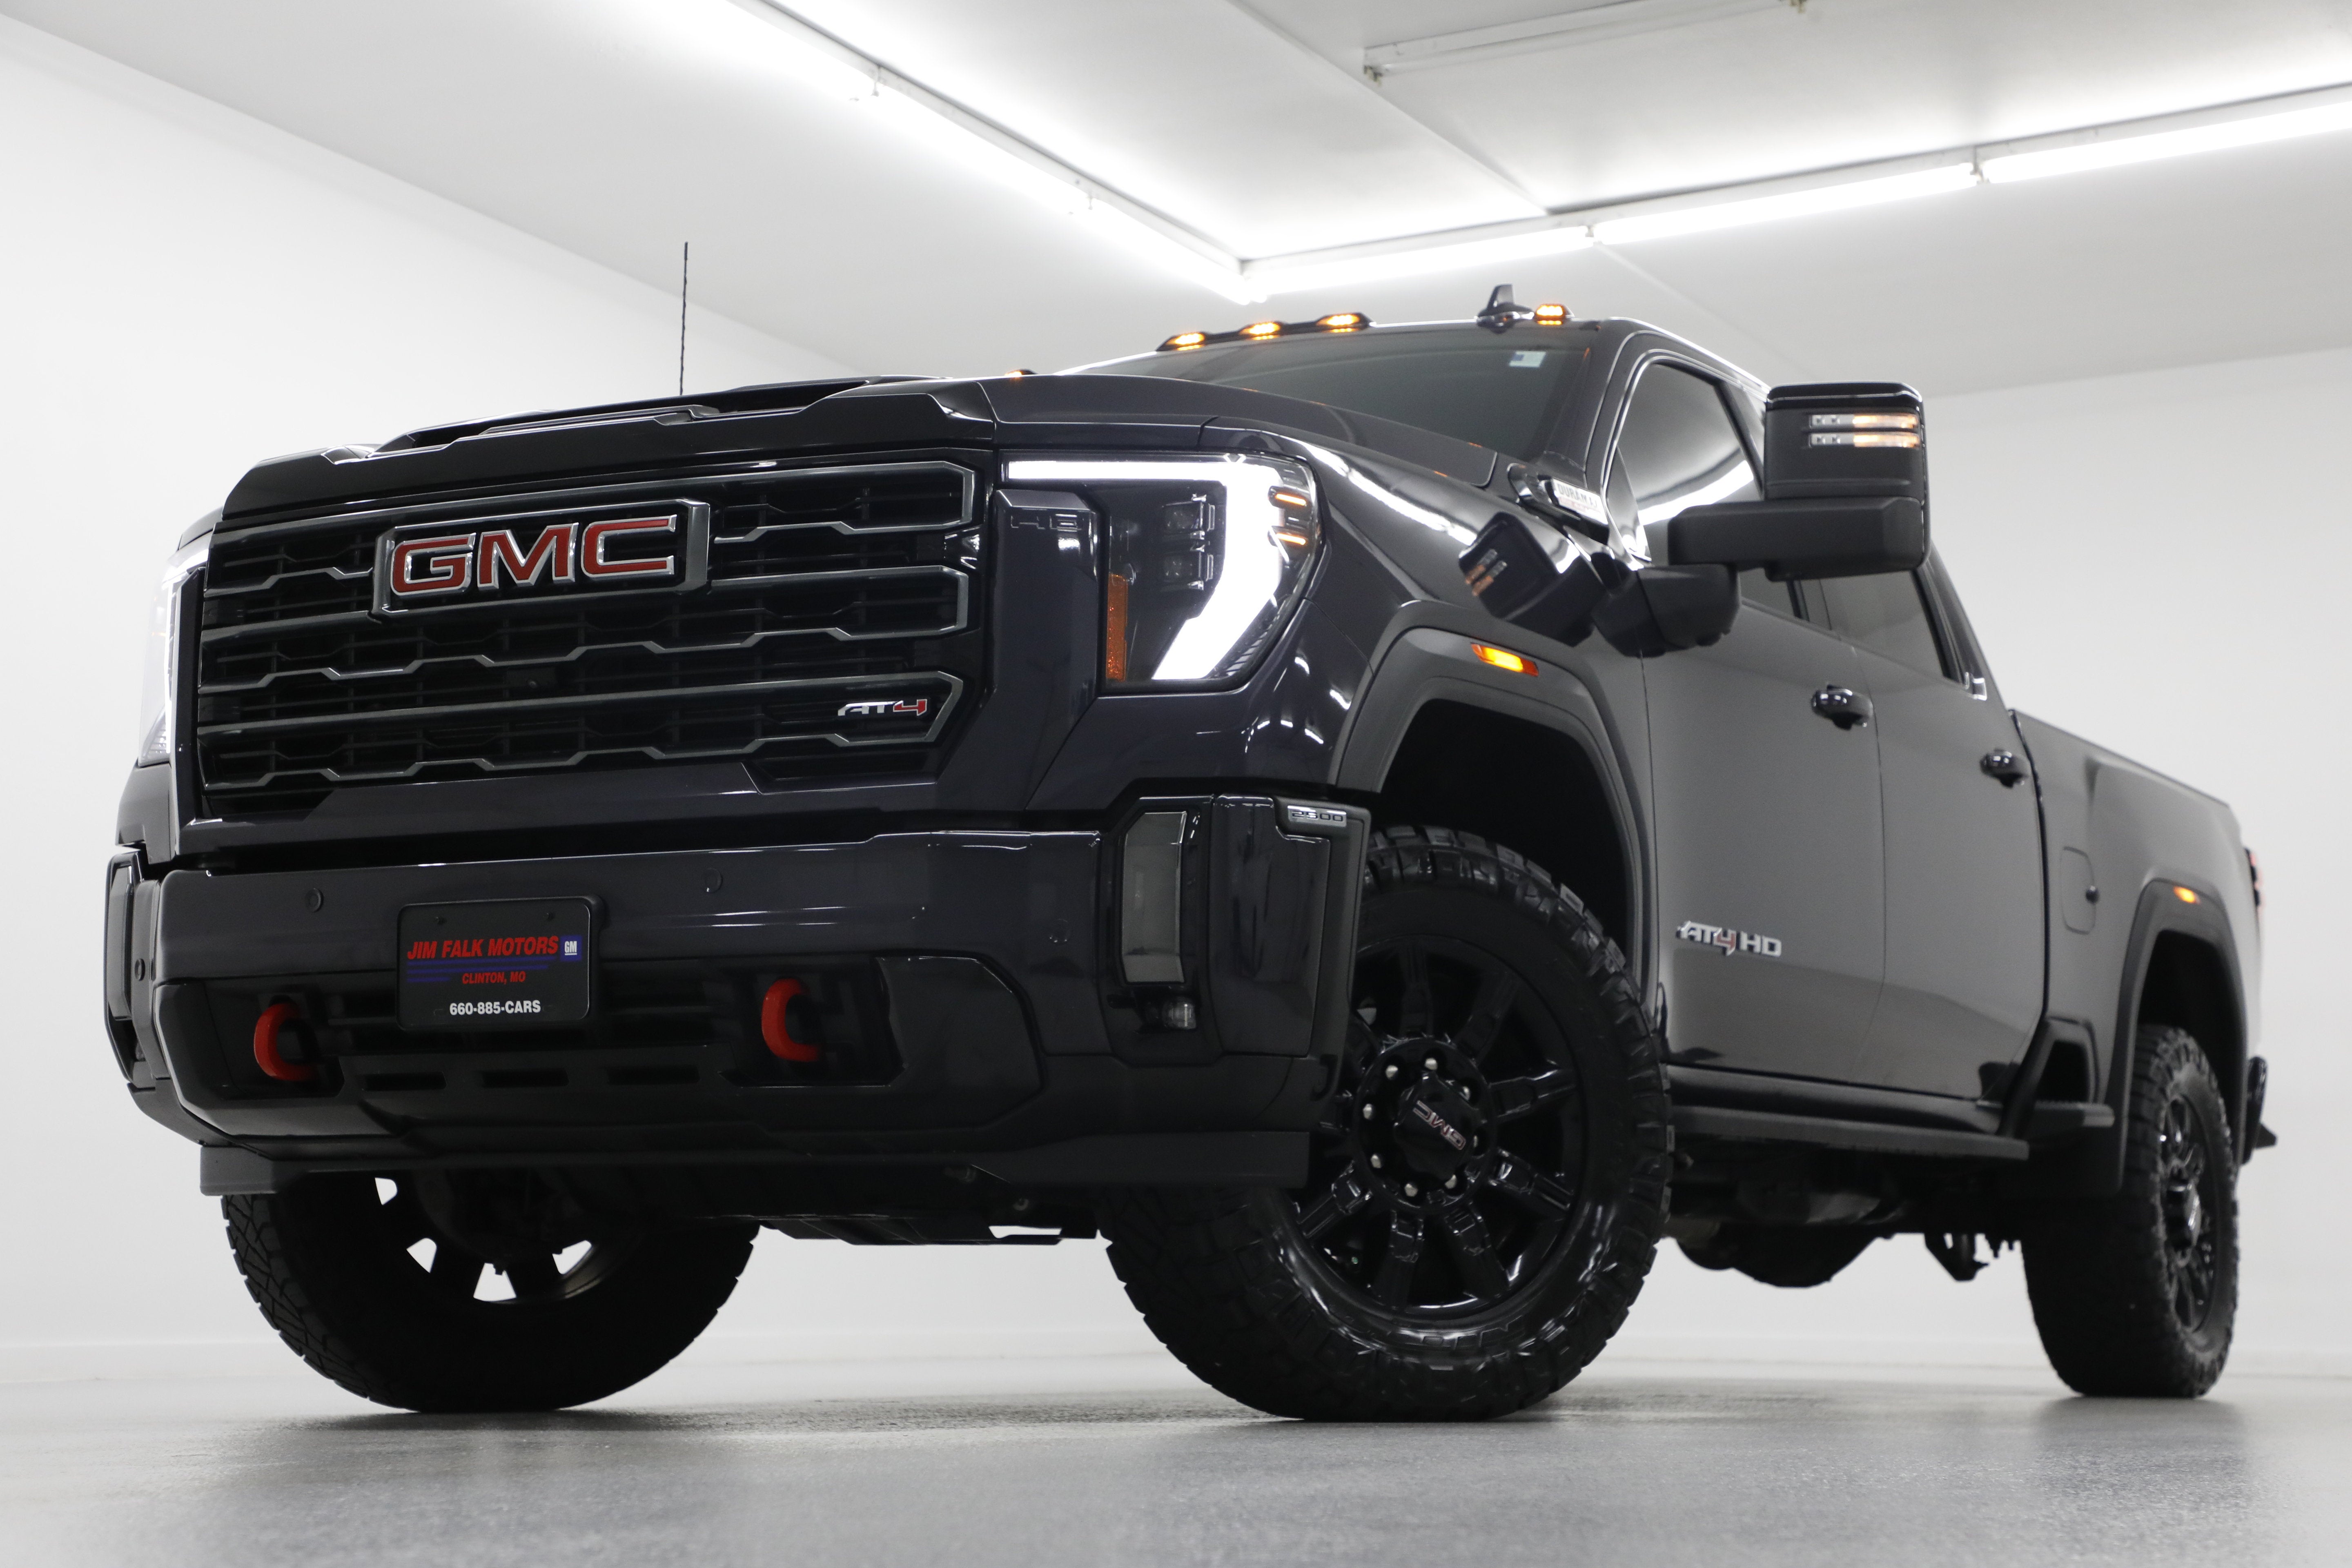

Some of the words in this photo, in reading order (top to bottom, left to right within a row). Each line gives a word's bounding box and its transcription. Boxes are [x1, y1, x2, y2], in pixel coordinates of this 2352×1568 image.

[390, 514, 677, 596] GMC
[838, 699, 927, 716] AT4
[1292, 810, 1343, 822] 2500
[564, 941, 577, 953] GM
[1676, 920, 1736, 956] AT4
[1740, 931, 1782, 958] HD
[408, 941, 437, 960] JIM
[441, 939, 483, 958] FALK
[488, 936, 559, 956] MOTORS
[462, 972, 507, 984] CLINTON,
[510, 971, 526, 982] MO
[450, 1000, 541, 1016] 660-885-CARS
[1413, 1100, 1466, 1150] GMC
